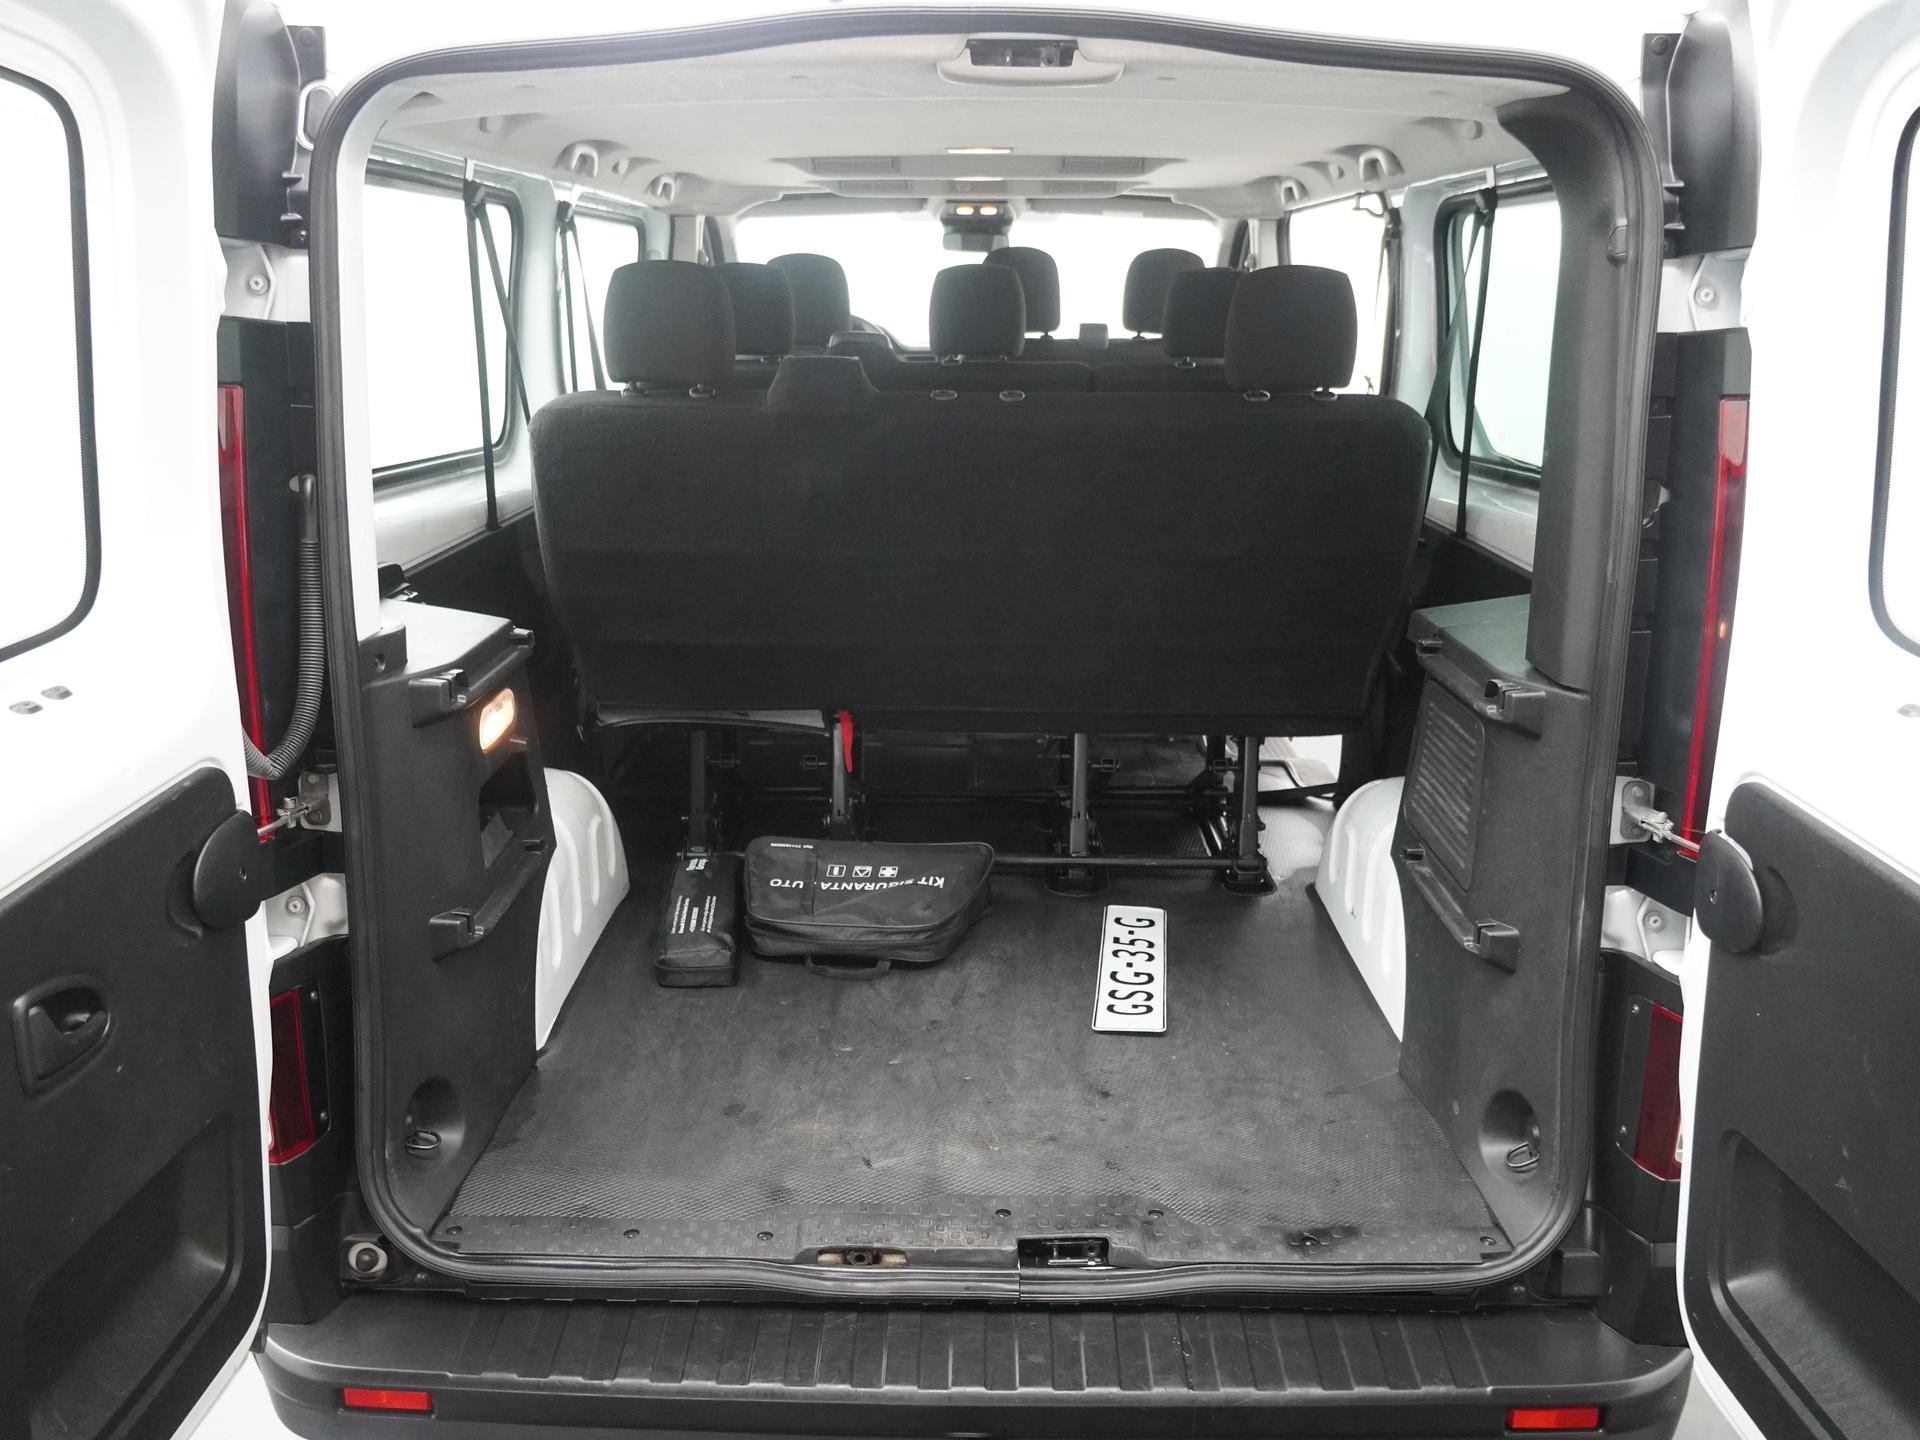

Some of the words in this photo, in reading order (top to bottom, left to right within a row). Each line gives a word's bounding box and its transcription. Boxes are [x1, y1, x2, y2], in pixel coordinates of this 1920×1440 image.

[769, 878, 817, 889] UTO
[917, 876, 945, 889] KIT
[1106, 916, 1156, 1016] GSG-35-G
